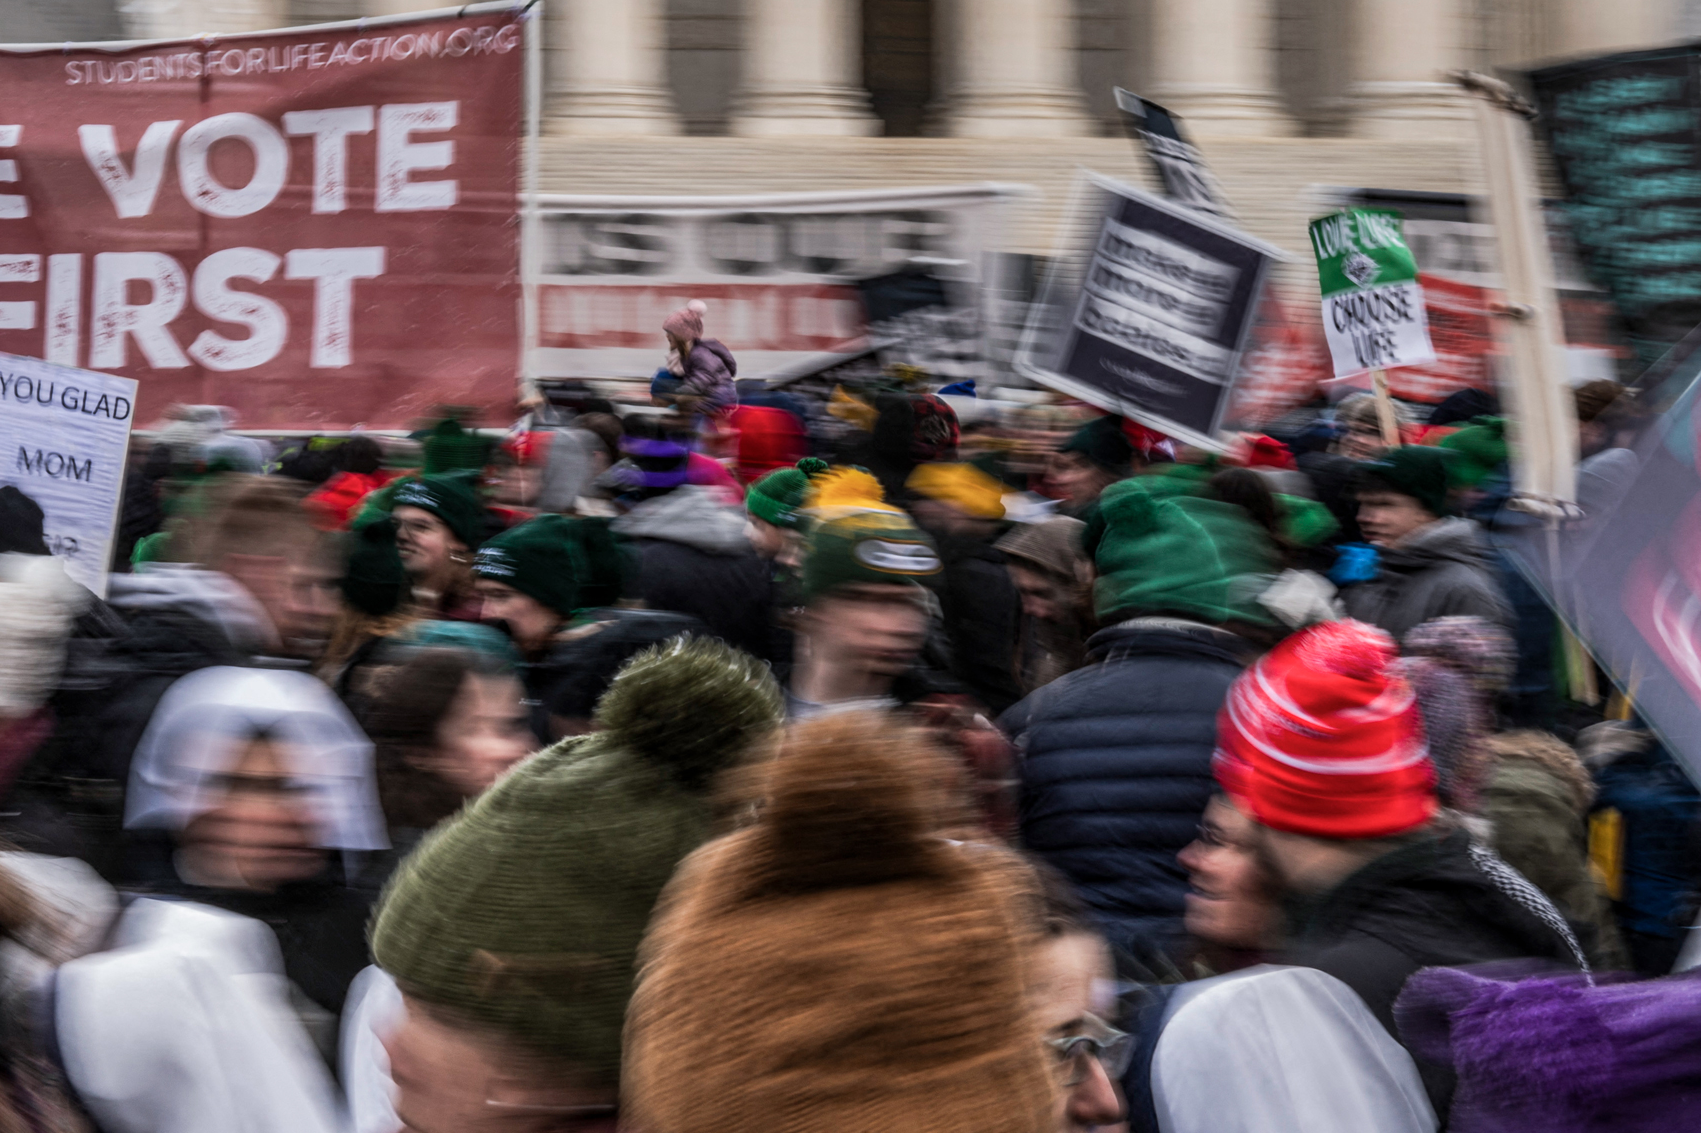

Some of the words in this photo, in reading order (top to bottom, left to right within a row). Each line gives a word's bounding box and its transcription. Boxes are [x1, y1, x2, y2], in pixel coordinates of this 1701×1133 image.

[65, 24, 520, 86] STUDENTSFORLIFEACTION.ORG
[78, 101, 460, 219] VOTE
[60, 385, 131, 422] GLAD
[16, 444, 93, 483] MOM
